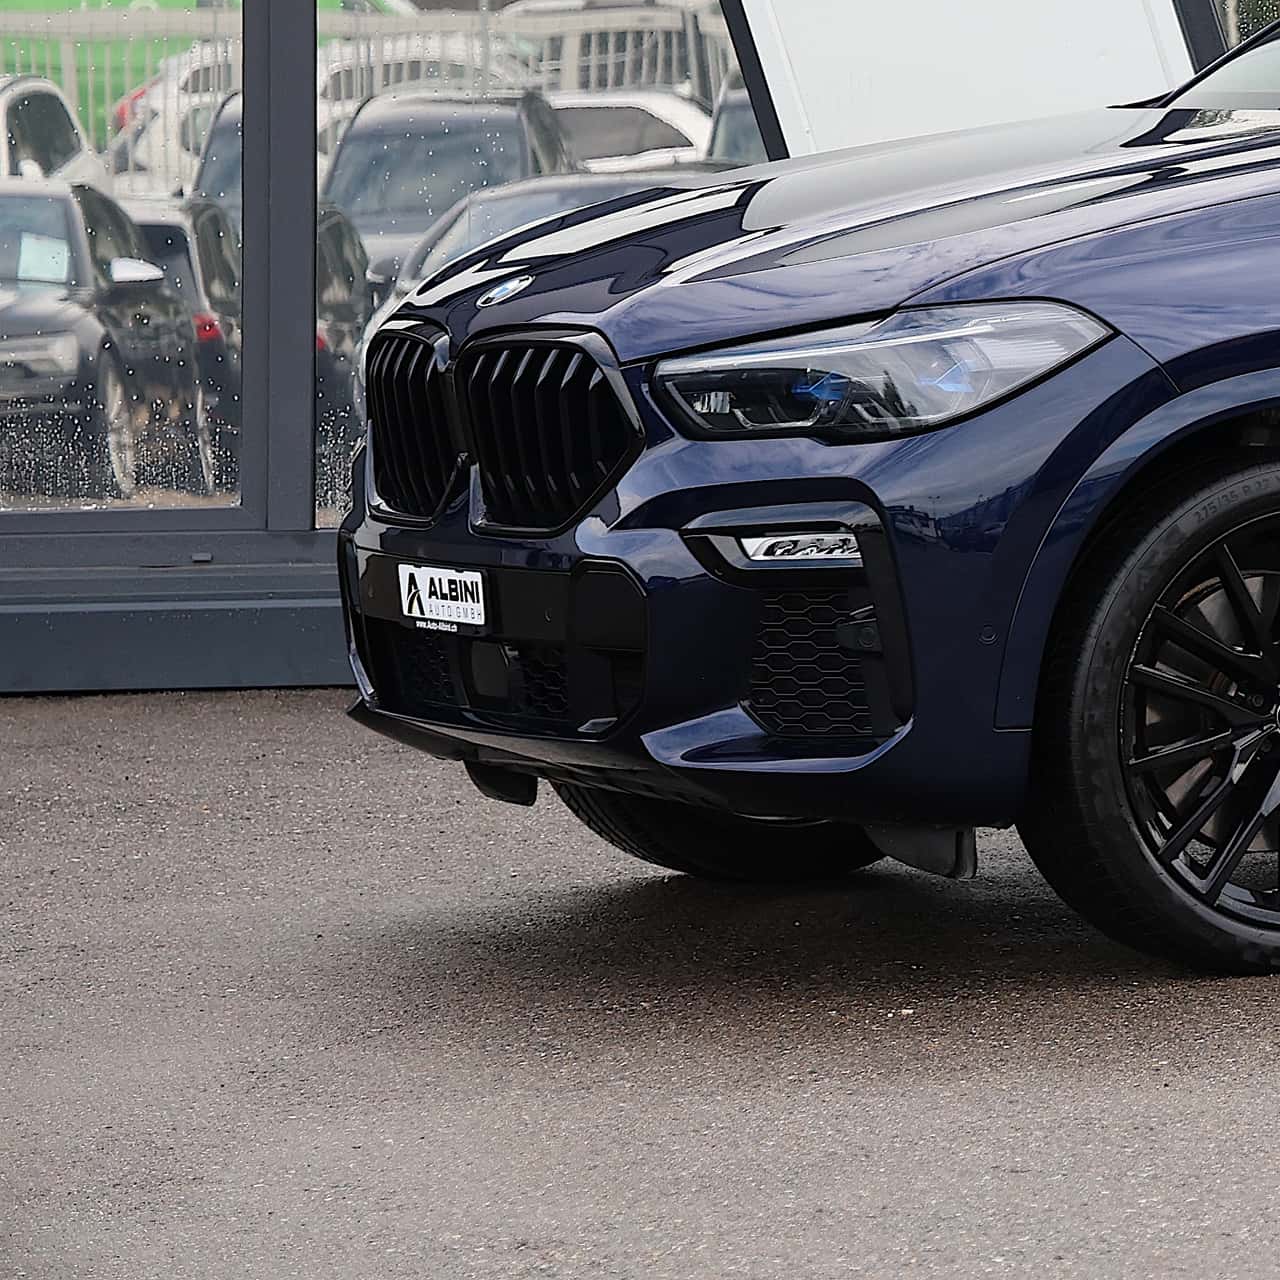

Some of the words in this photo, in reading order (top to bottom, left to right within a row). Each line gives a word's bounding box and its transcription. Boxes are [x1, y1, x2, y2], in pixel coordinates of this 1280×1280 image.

[428, 577, 480, 603] ALBINI
[428, 603, 452, 617] AUTO
[455, 605, 481, 620] GMBH
